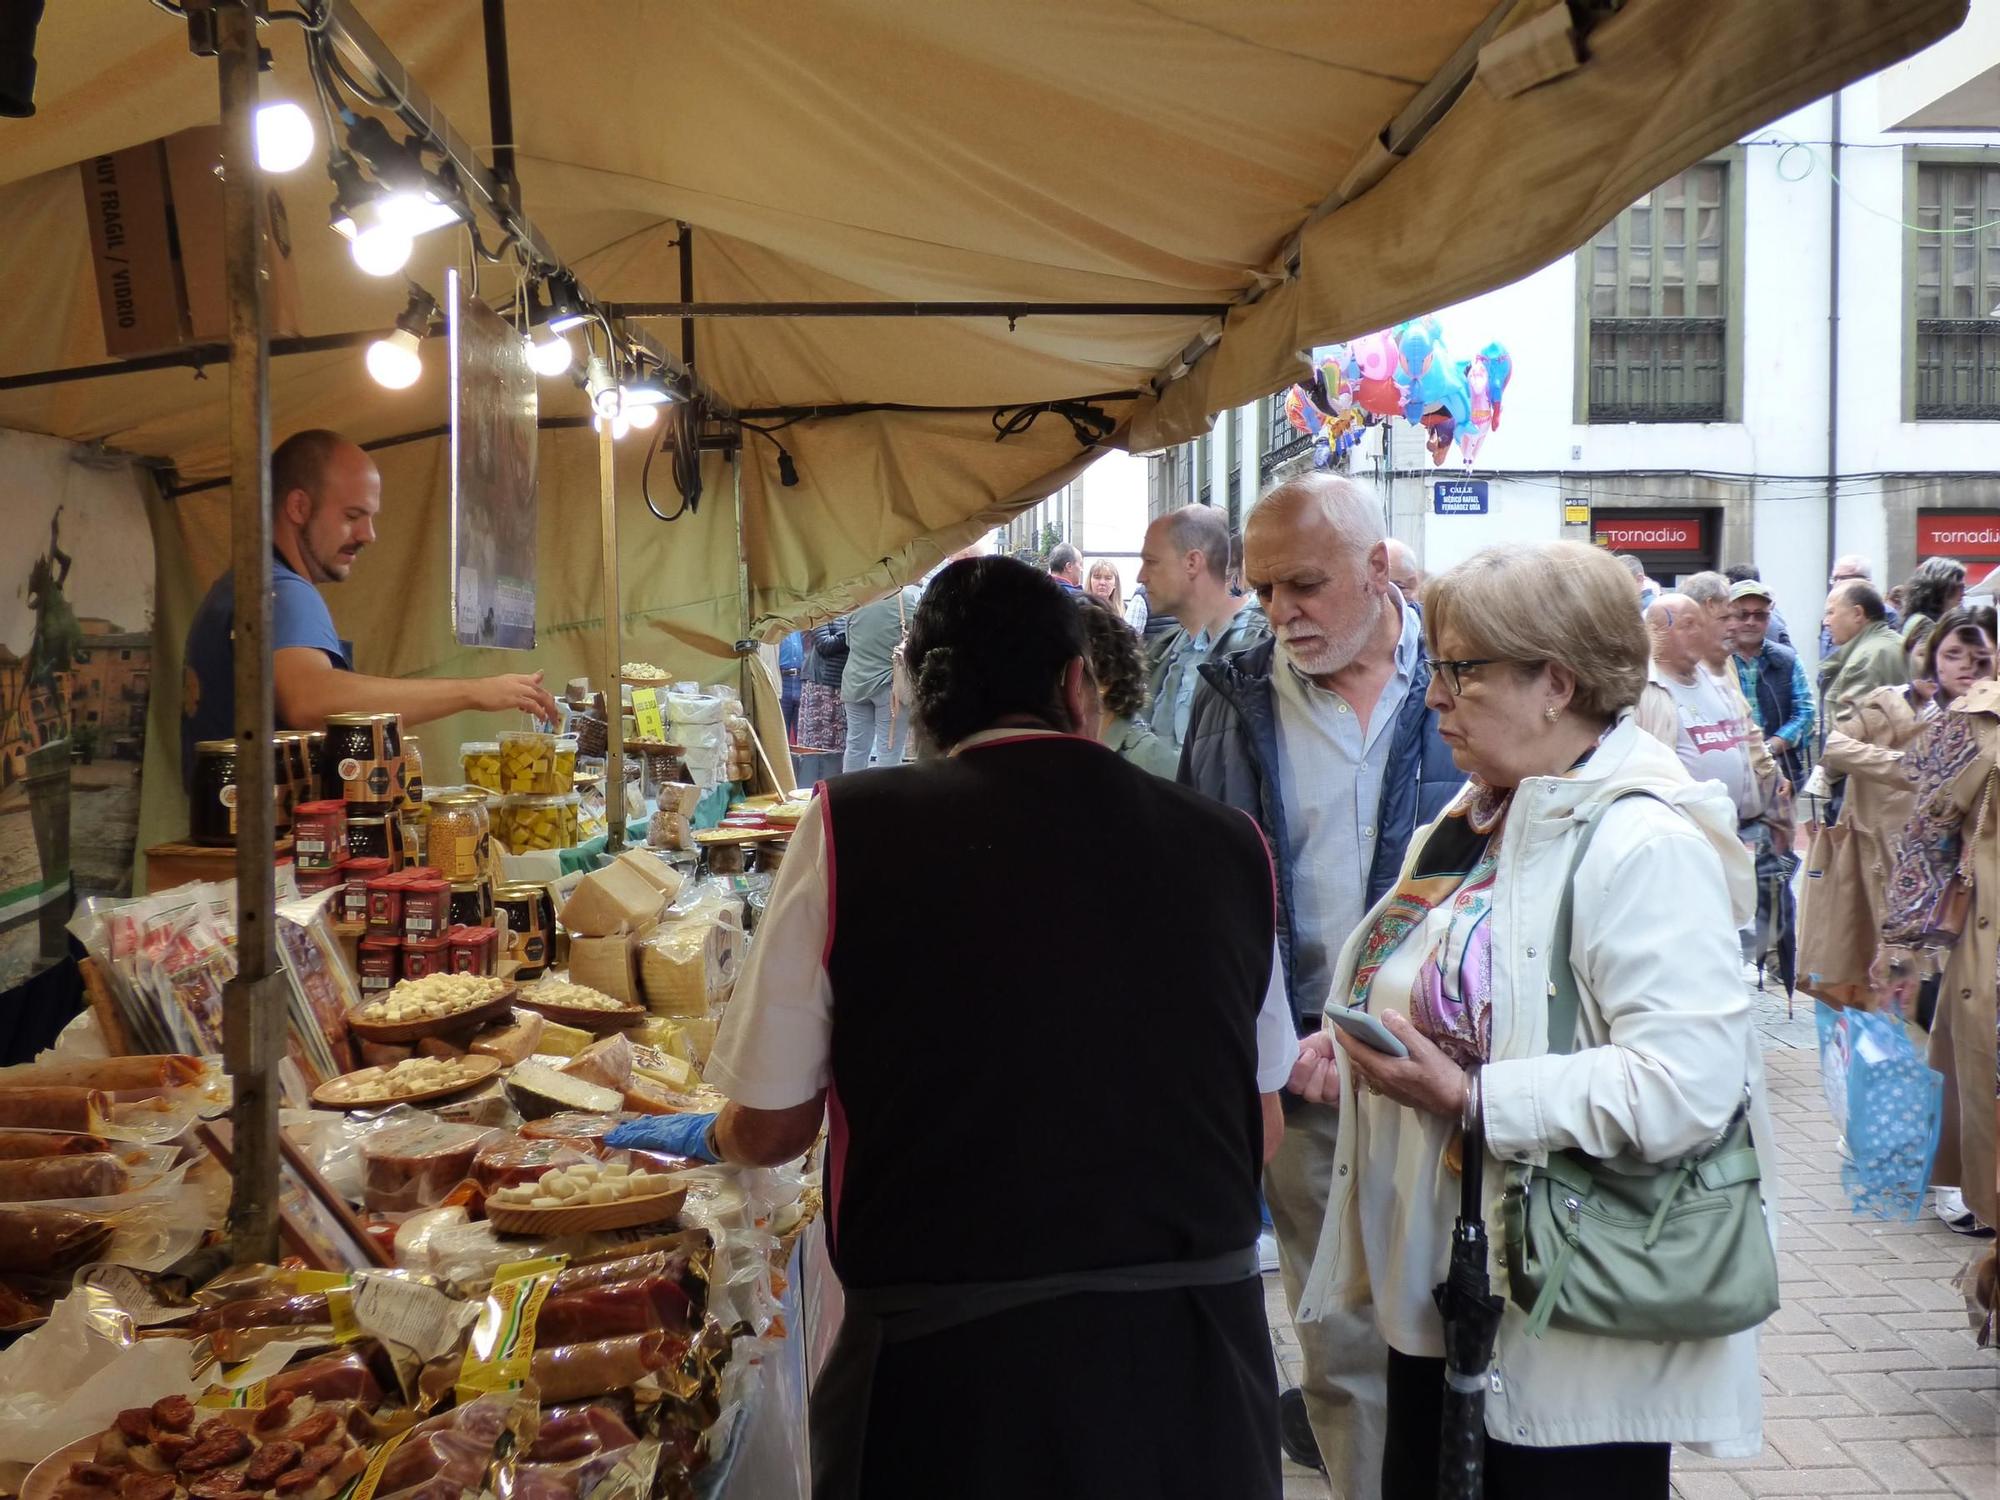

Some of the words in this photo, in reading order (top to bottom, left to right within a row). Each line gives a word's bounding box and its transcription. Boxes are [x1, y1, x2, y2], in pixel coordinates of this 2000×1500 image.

[101, 190, 126, 250] FRAGIL
[112, 270, 135, 329] VIDRIO
[1930, 528, 2000, 543] Tornadij
